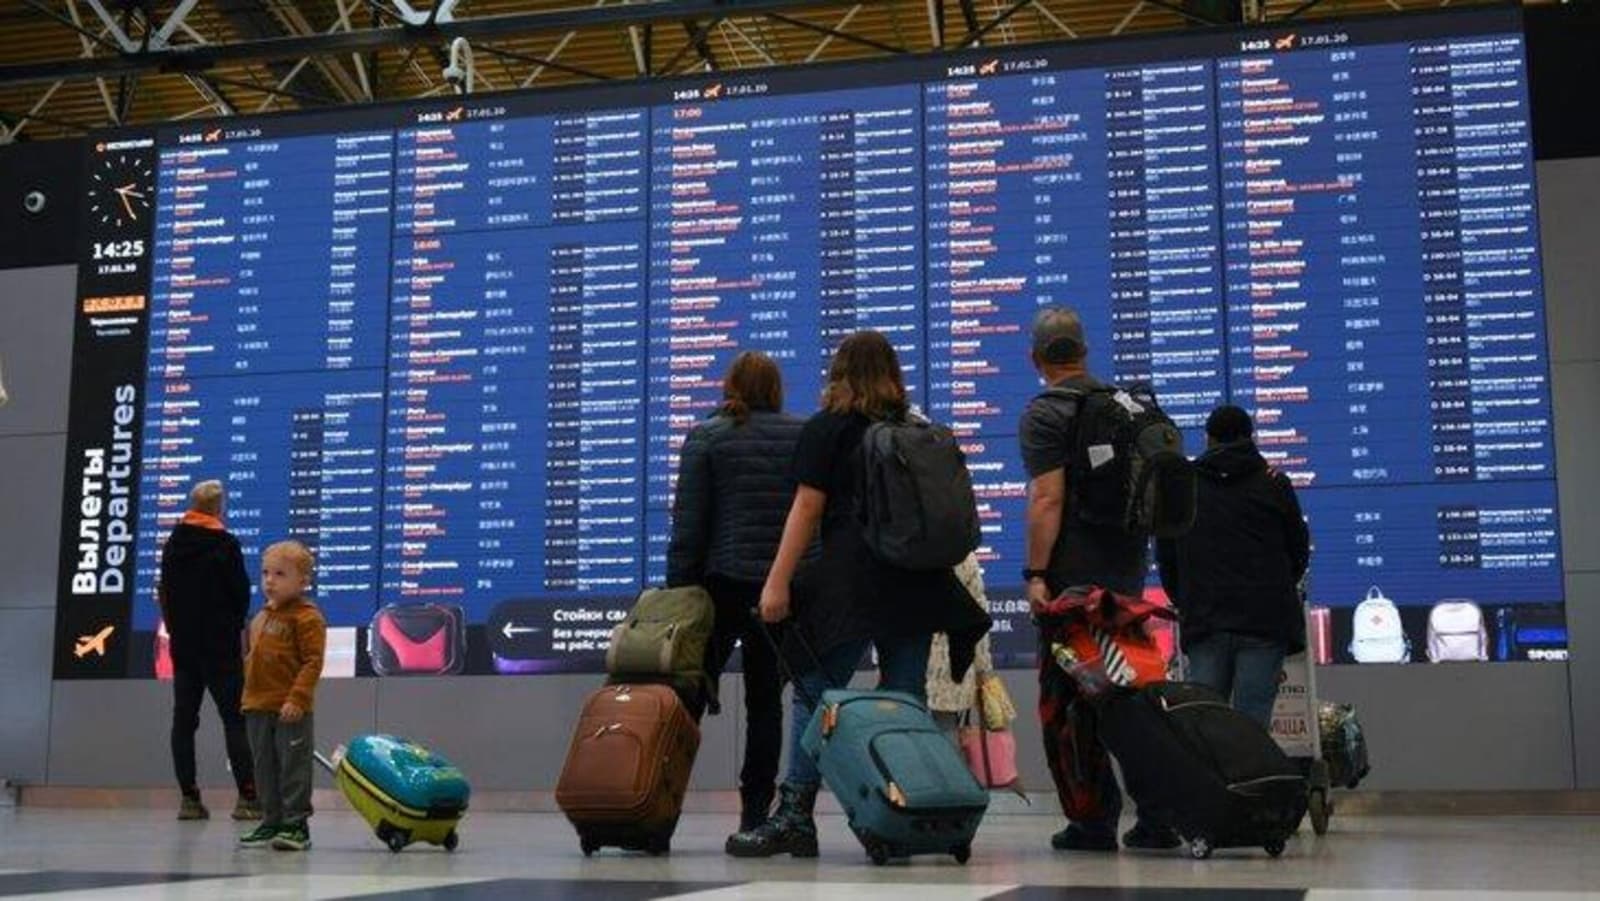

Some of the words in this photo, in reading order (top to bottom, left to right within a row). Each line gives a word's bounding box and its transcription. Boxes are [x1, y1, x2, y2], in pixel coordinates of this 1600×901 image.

[93, 240, 145, 259] 14:25
[72, 448, 104, 594] Вылеты
[101, 384, 136, 593] Departures
[553, 608, 604, 622] Стойки
